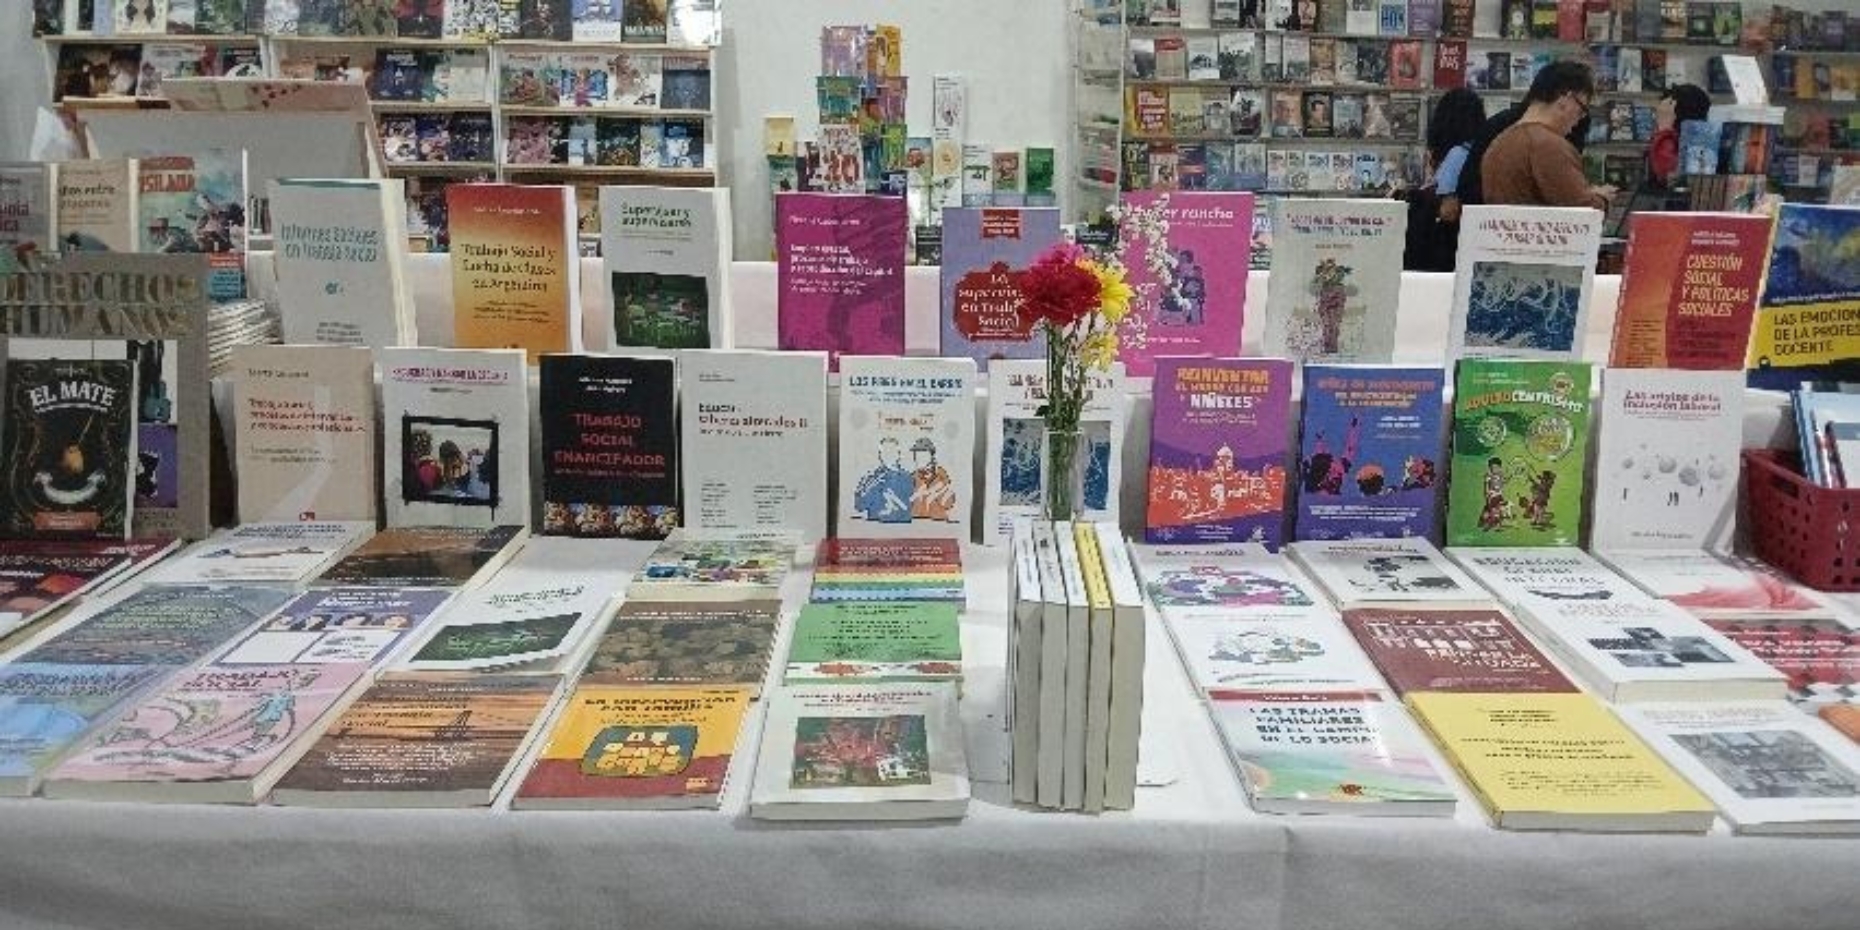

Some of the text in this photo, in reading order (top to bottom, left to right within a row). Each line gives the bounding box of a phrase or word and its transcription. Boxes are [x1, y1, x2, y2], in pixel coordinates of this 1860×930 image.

[1774, 313, 1797, 325] LAS
[1774, 328, 1791, 341] DE
[1794, 327, 1811, 340] LA
[1774, 340, 1834, 356] DOCENTE
[31, 381, 115, 407] EL MATE
